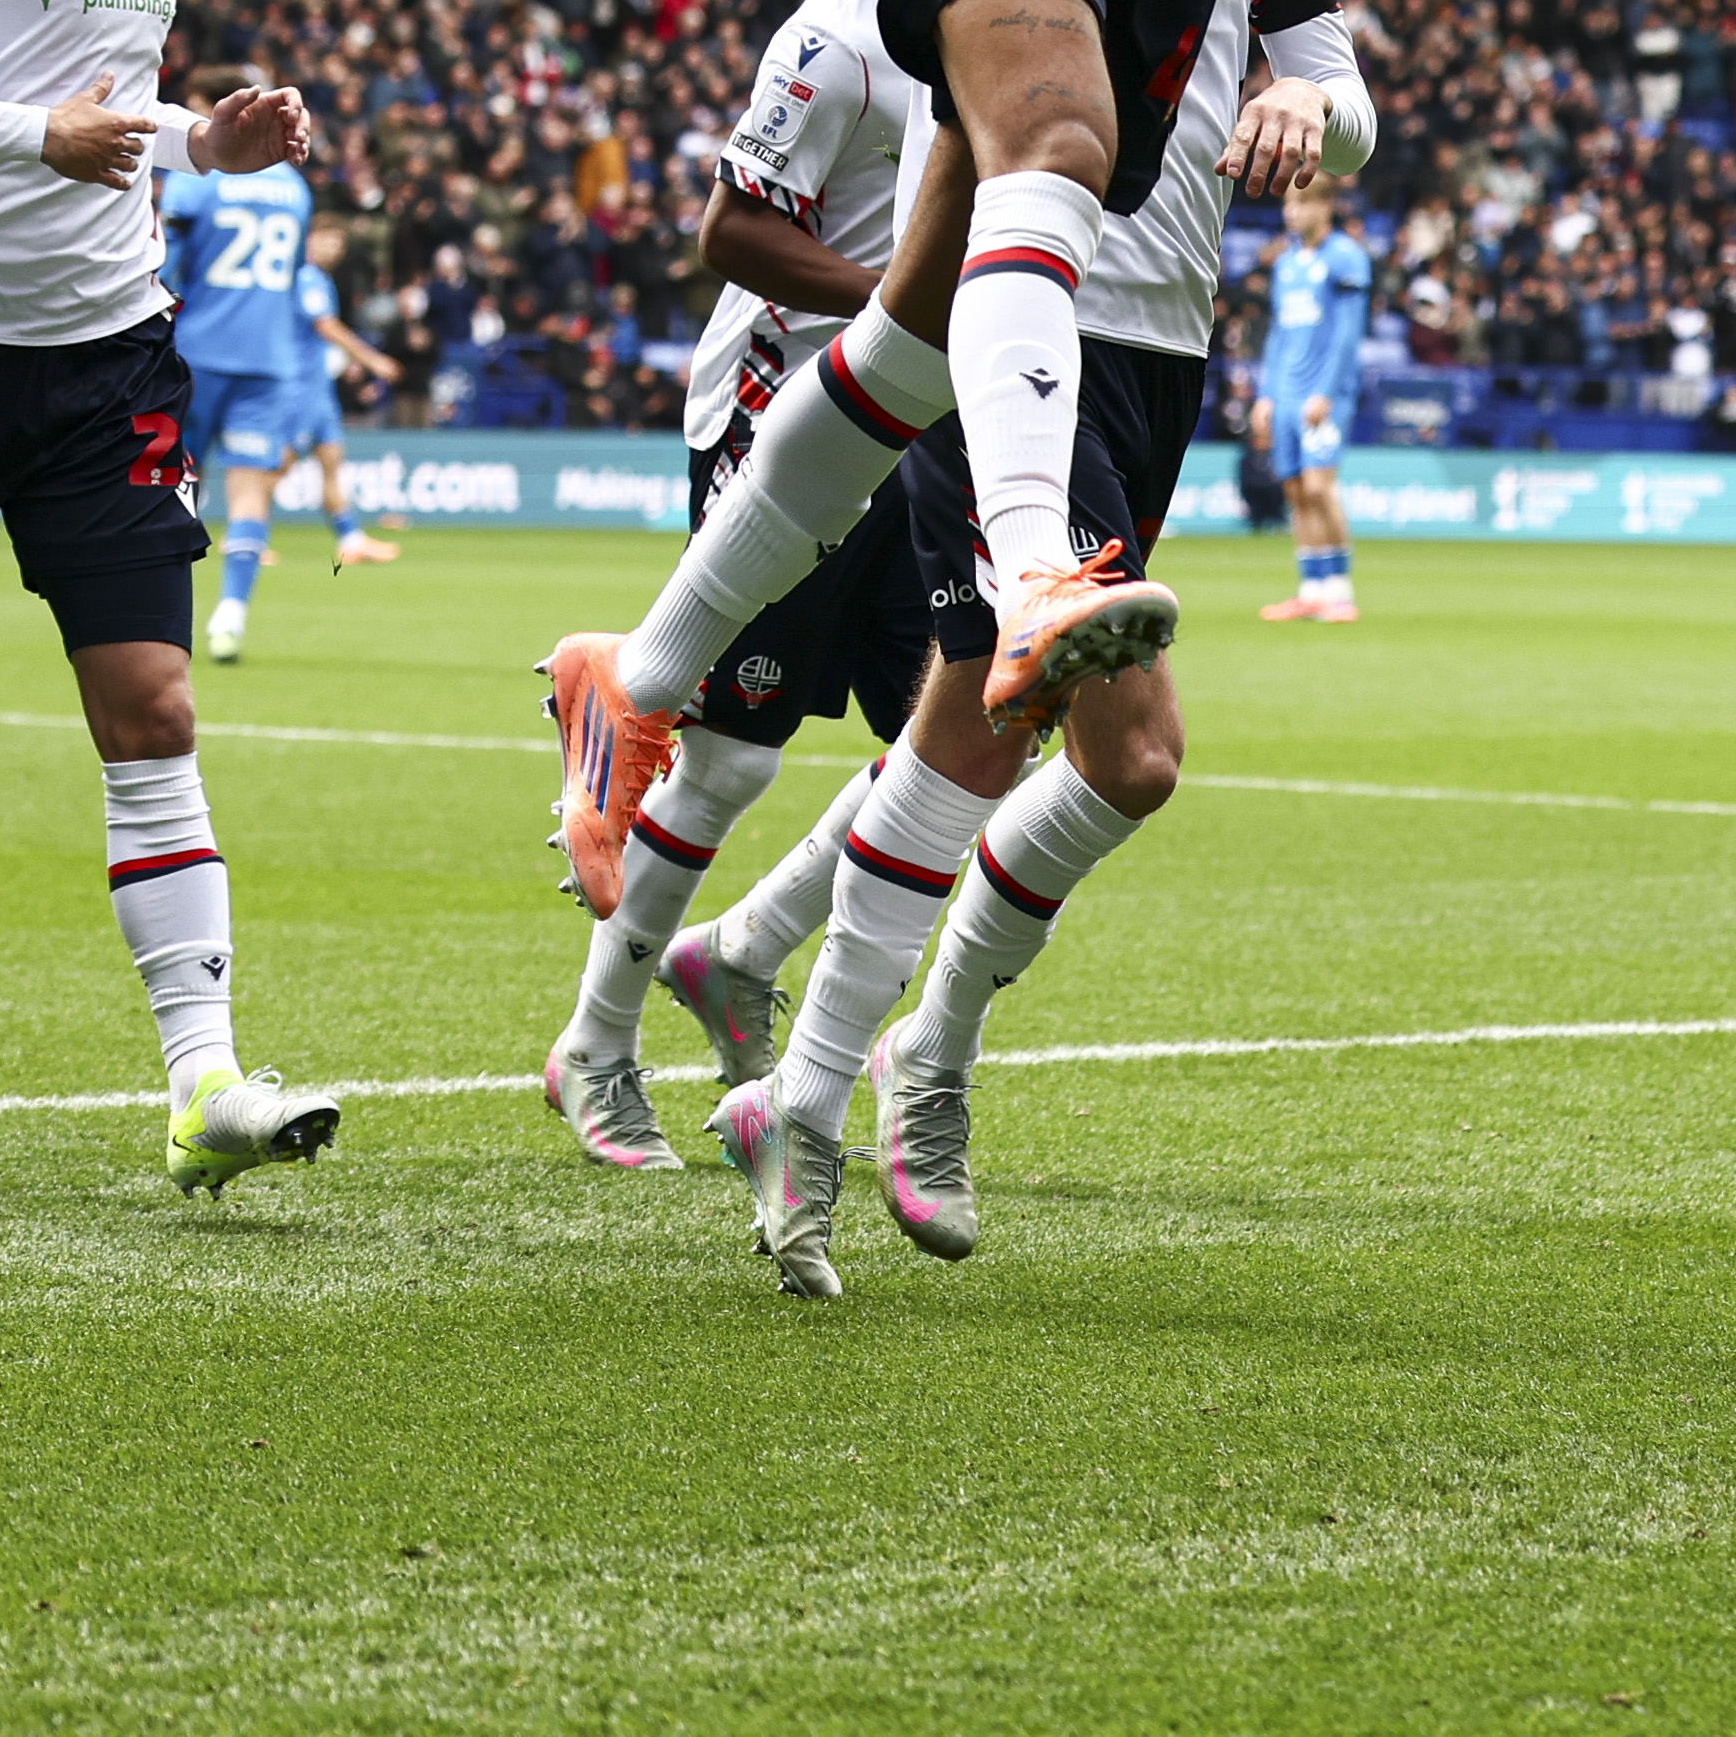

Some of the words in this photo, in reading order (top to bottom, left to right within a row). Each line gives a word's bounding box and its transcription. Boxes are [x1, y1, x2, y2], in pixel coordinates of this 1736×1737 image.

[790, 82, 813, 101] bet
[761, 124, 777, 139] EFL
[205, 206, 302, 293] 28
[128, 412, 181, 487] 2
